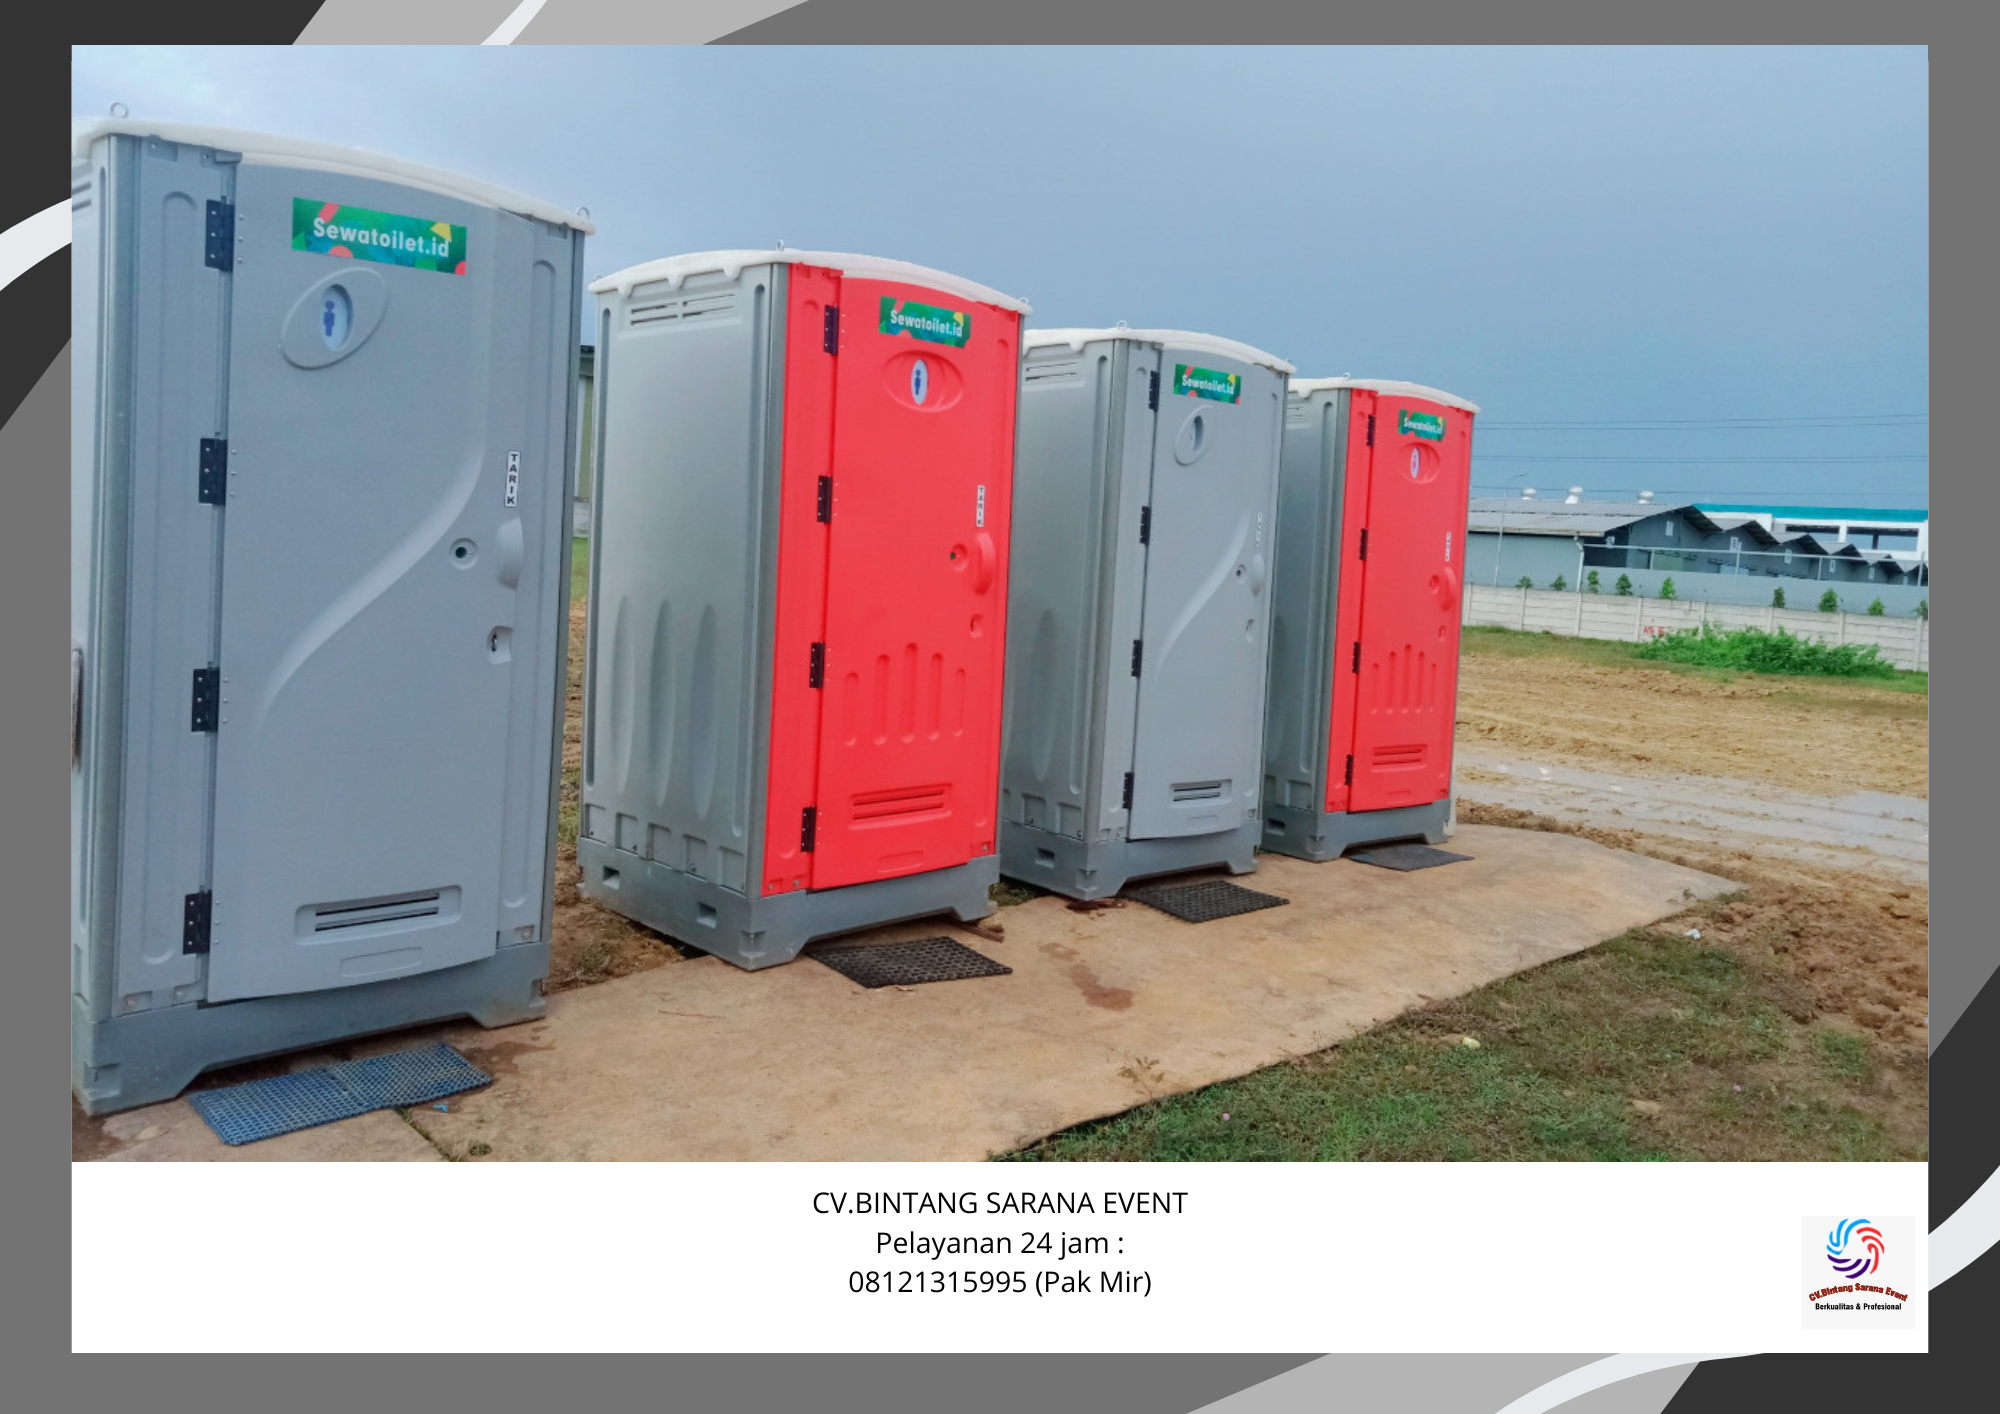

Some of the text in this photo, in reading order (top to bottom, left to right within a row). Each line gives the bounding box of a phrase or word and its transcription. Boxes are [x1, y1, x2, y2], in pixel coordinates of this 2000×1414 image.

[313, 217, 449, 257] Sewatoilet.id
[890, 309, 963, 338] Sewatoilet.id
[507, 453, 519, 505] TARIK
